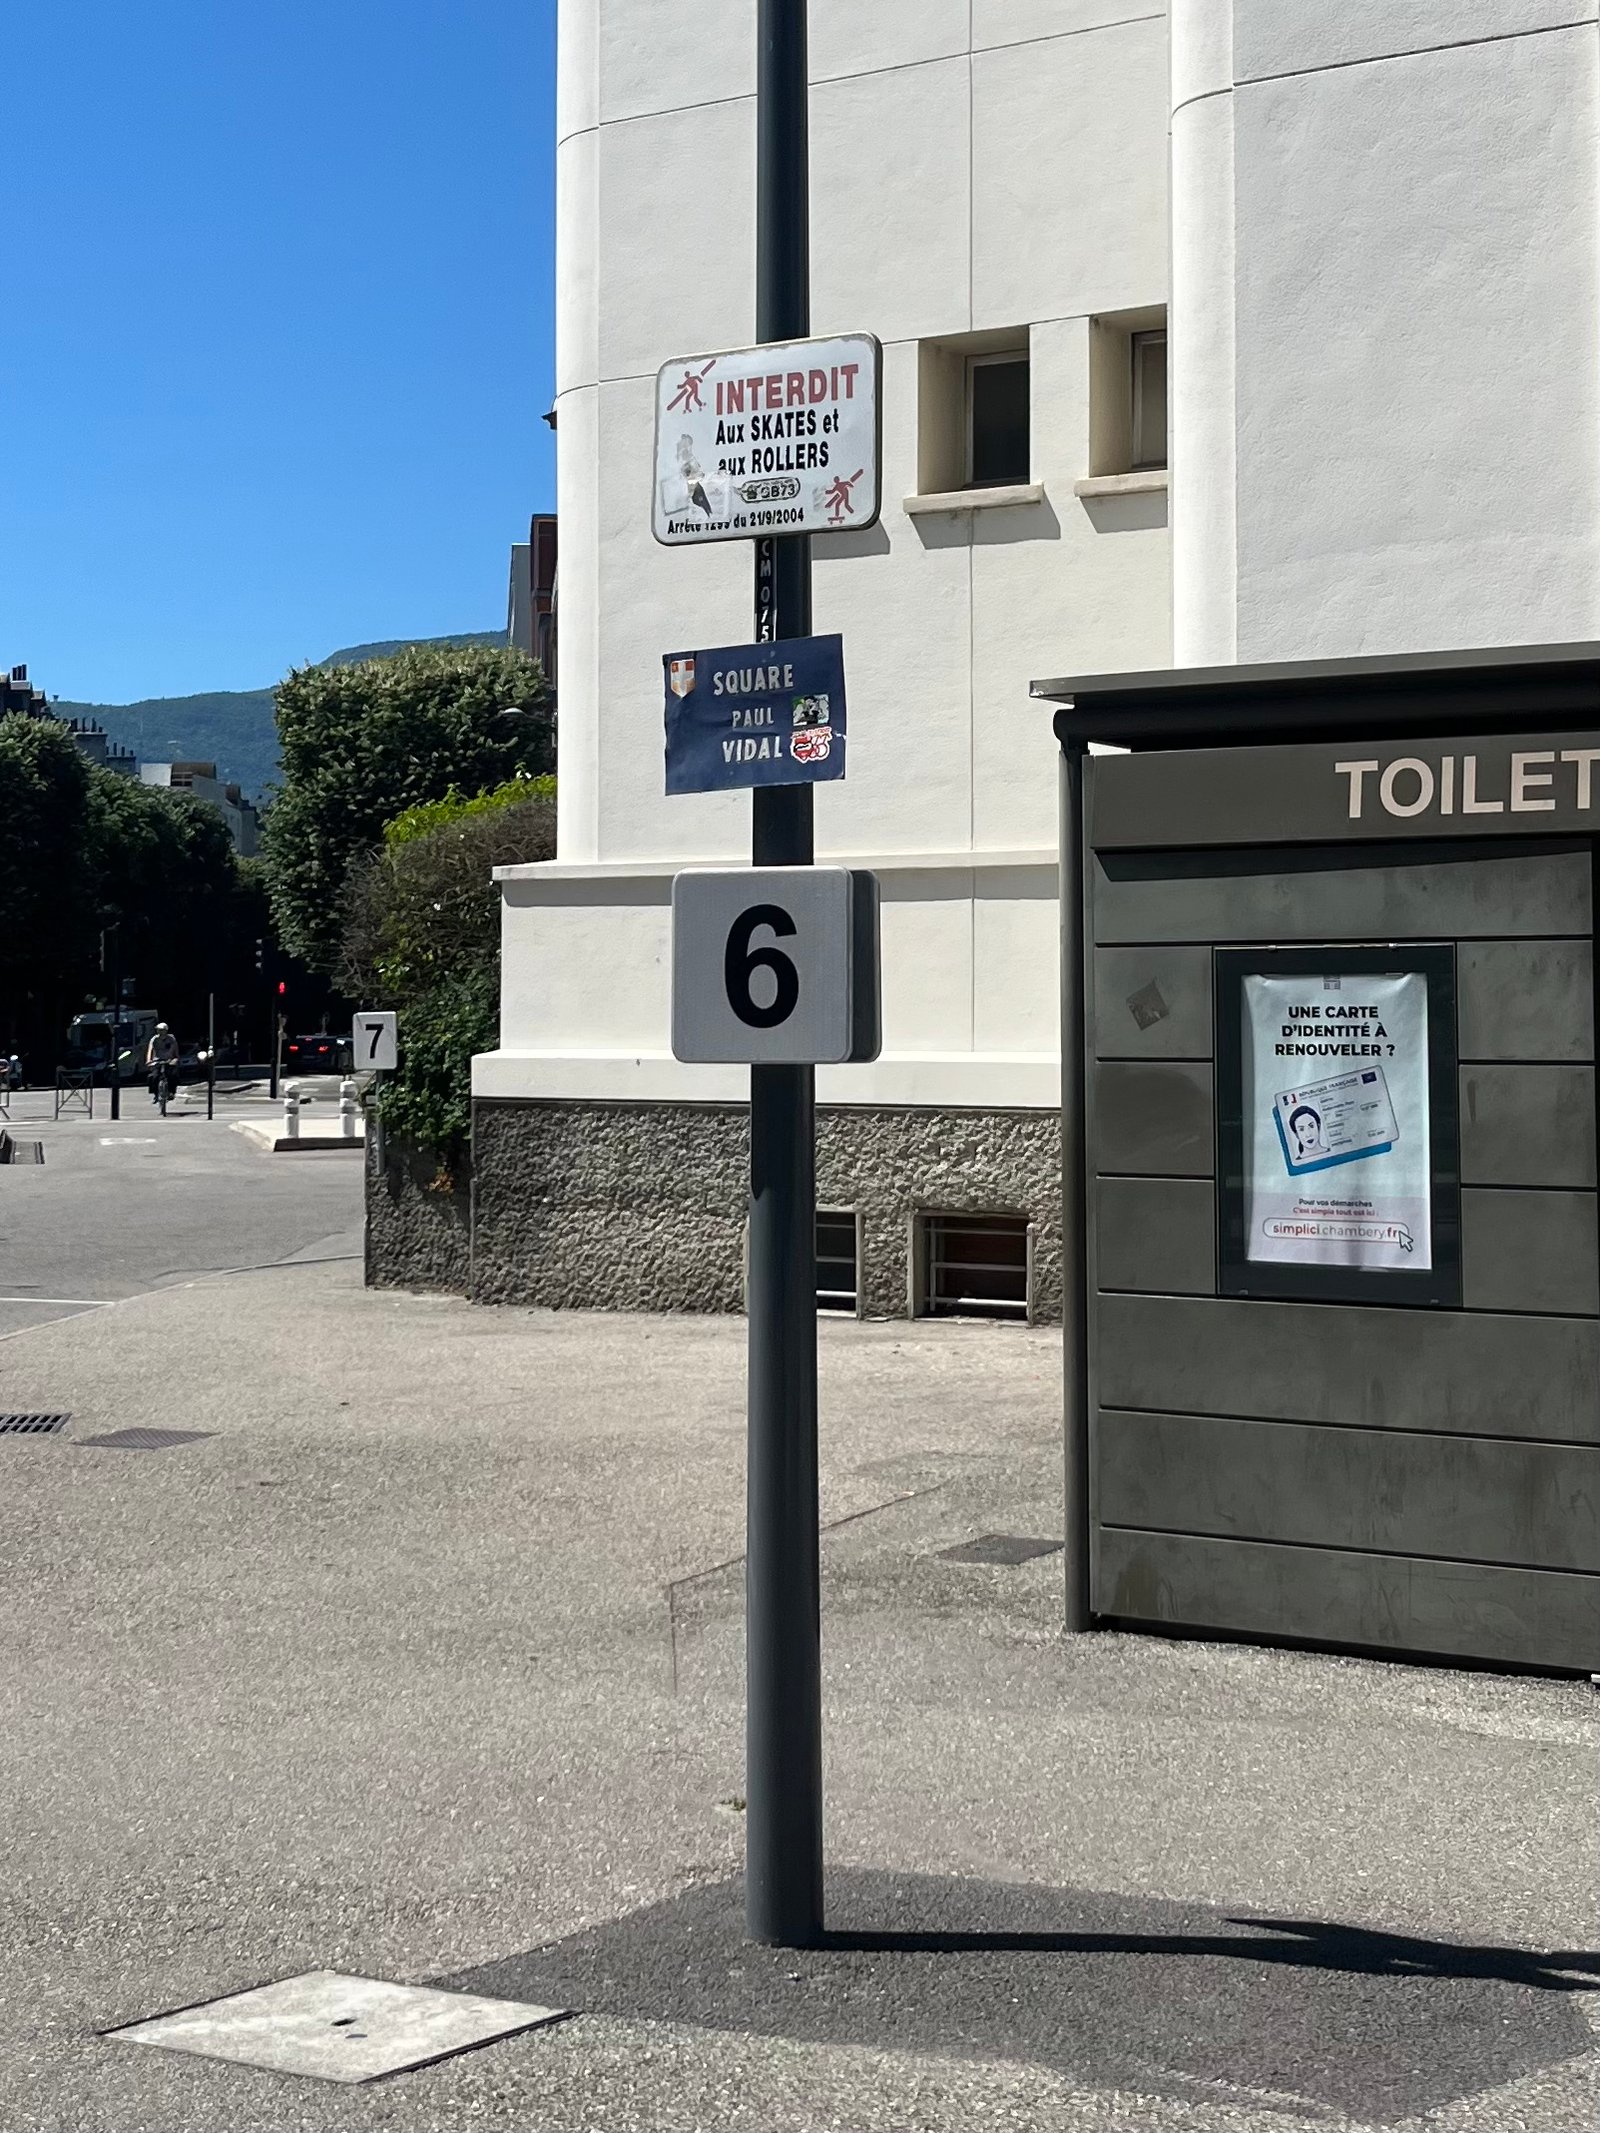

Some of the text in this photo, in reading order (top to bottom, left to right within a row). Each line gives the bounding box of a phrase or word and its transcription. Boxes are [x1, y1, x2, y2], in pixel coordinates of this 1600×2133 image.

[716, 364, 859, 415] INTERDIT
[715, 409, 839, 445] Aux SKATES et
[718, 441, 829, 476] aux ROLLERS
[733, 513, 747, 529] du
[749, 507, 805, 527] 21/9/2004
[713, 664, 794, 696] SQUARE
[732, 707, 775, 729] PAUL
[722, 735, 783, 763] VIDAL
[1334, 749, 1600, 818] TOILET
[725, 904, 799, 1028] 6
[1288, 1006, 1379, 1018] UNE CARTE
[365, 1023, 384, 1059] 7
[1375, 1022, 1388, 1037] À
[1275, 1044, 1396, 1057] RENOUVELER ?
[1299, 1198, 1315, 1206] Pour
[1330, 1199, 1372, 1208] démarches
[1273, 1222, 1398, 1239] simplici.chambery.fr
